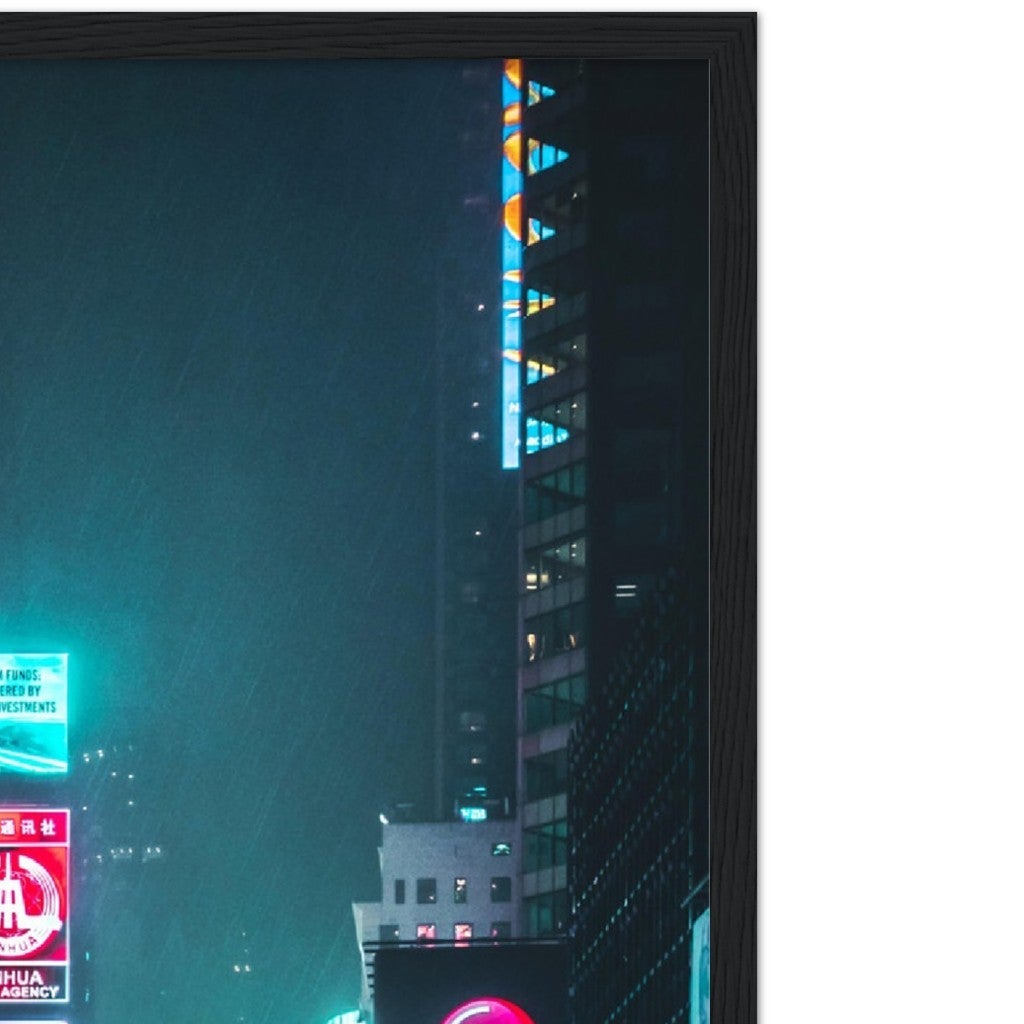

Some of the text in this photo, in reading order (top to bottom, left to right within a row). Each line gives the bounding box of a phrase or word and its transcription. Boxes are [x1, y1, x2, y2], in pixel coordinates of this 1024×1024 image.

[6, 669, 41, 681] FUNDS:
[28, 685, 42, 697] BY
[0, 986, 60, 999] AGENCY
